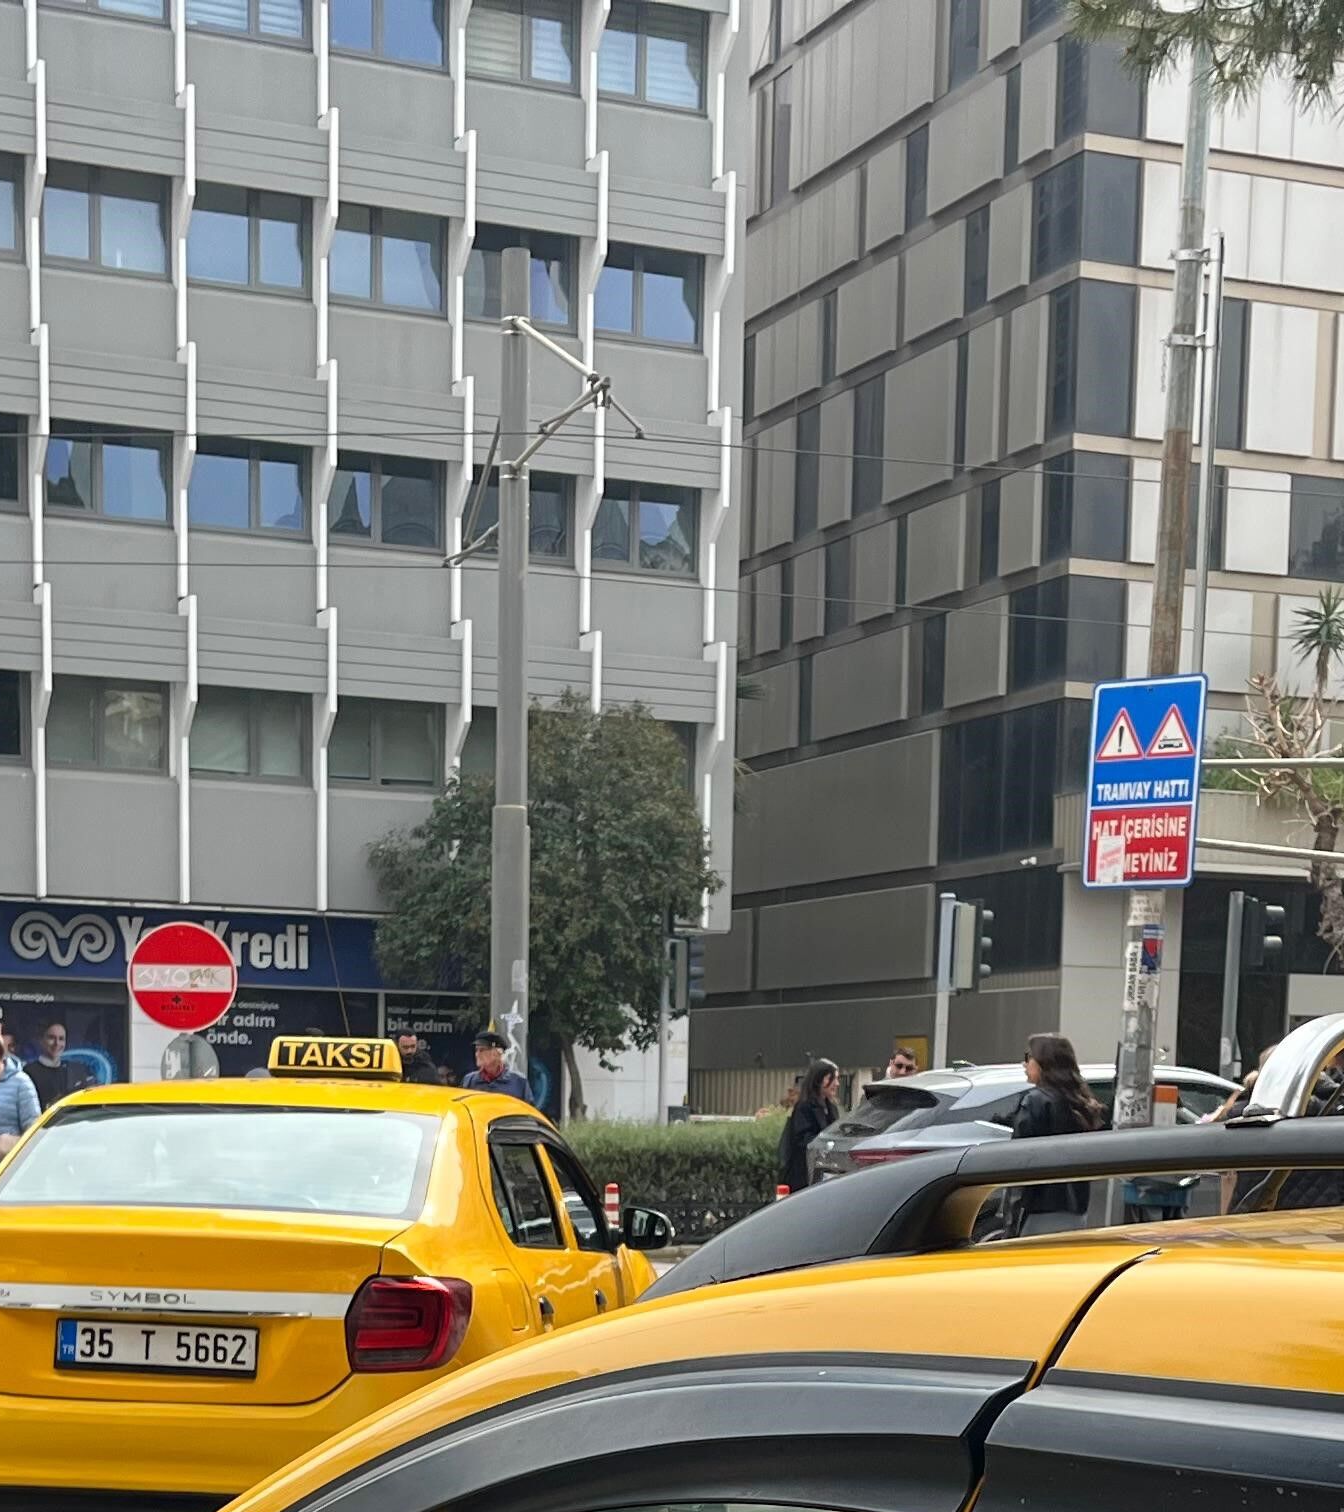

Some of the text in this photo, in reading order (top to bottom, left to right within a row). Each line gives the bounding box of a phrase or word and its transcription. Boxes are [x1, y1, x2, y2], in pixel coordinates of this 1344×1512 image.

[1097, 779, 1190, 802] TRAMVAY HATTI
[1092, 812, 1188, 844] HAT İÇERİSİNE
[1123, 848, 1179, 874] MEYİNİZ
[233, 1013, 276, 1028] adım
[413, 1018, 453, 1033] adım
[206, 1028, 253, 1045] önde.
[90, 1290, 197, 1305] SYMBOL
[62, 1327, 248, 1366] TR 35 T 5662
